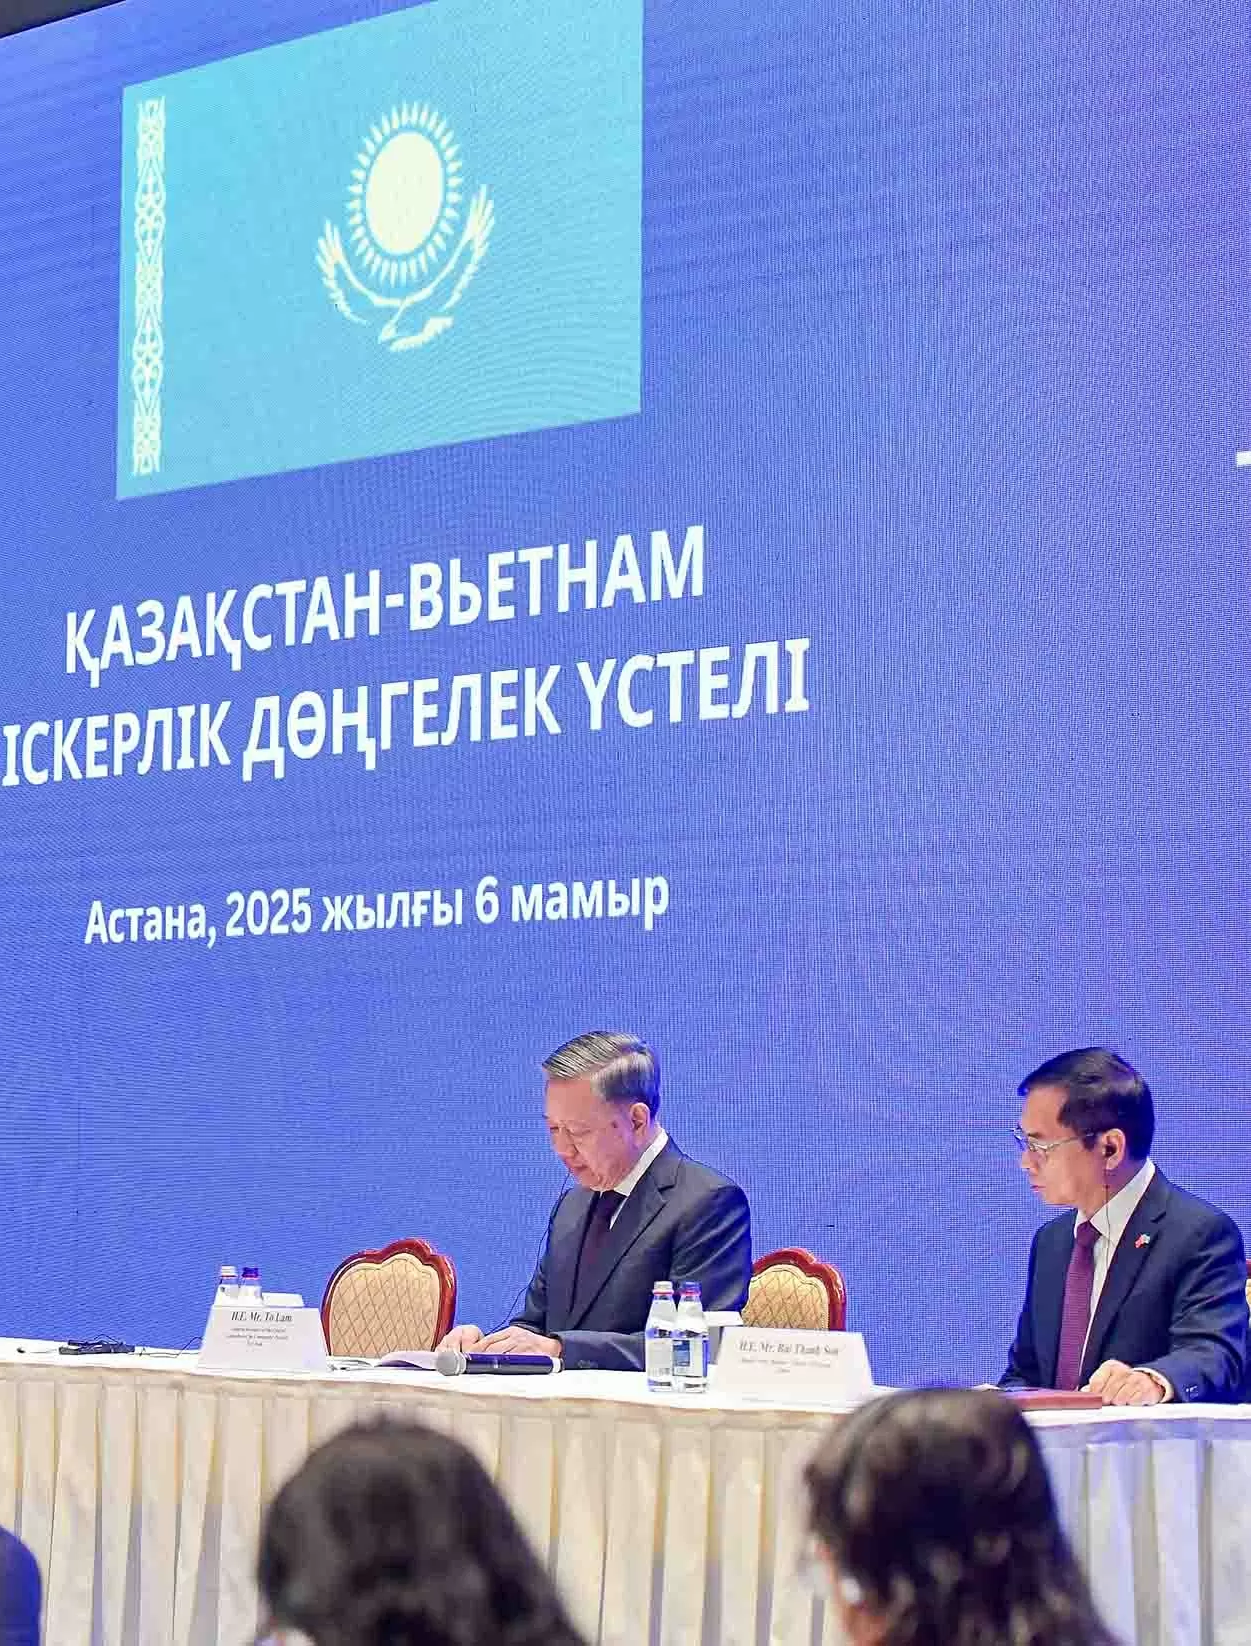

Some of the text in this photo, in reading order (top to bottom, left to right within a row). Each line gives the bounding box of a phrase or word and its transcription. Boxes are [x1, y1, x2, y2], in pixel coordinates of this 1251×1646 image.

[65, 526, 704, 688] ҚАЗАҚСТАН-ВЬЕТНАМ
[2, 638, 810, 786] ІСКЕРЛІК ДӨҢГЕЛЕК ҮСТЕЛІ
[85, 876, 669, 947] Астана, 2025 жылғы 6 мамыр
[250, 1311, 262, 1322] Mr.
